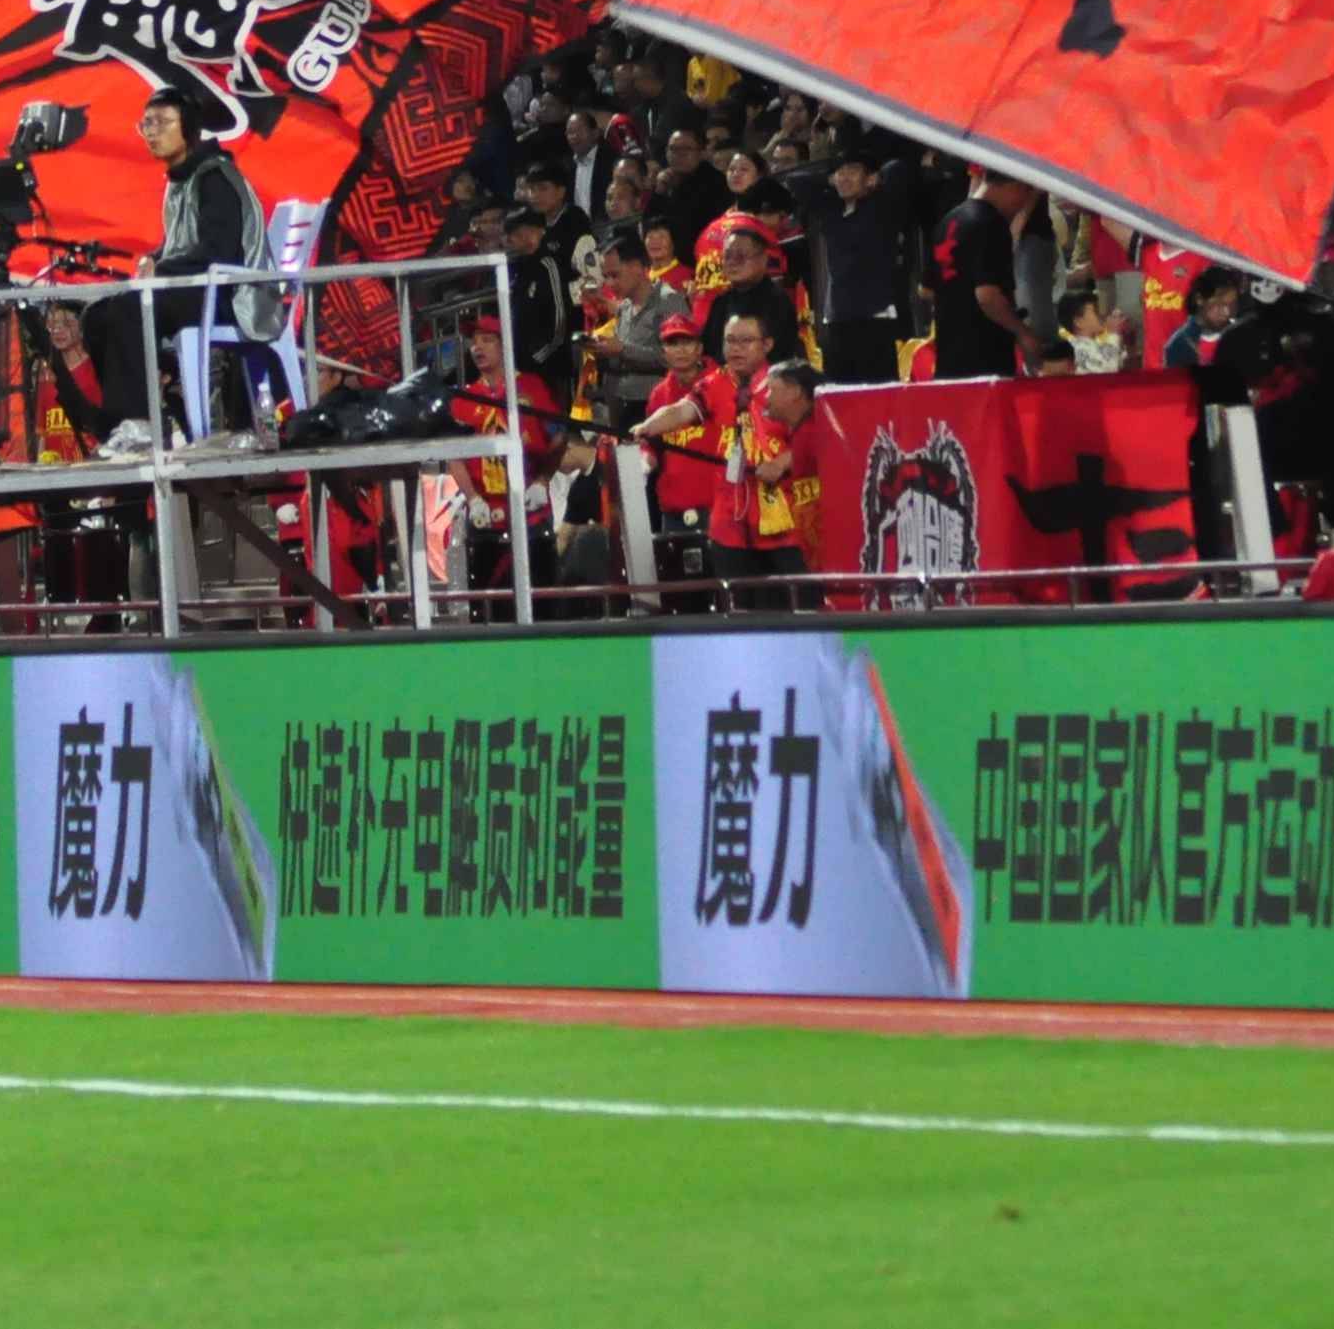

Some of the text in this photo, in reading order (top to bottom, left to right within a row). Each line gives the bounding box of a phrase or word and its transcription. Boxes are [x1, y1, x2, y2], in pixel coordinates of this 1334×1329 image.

[47, 703, 152, 921] 魔力
[277, 714, 627, 919] 快速补充电解质和能量
[696, 688, 820, 928] 魔力
